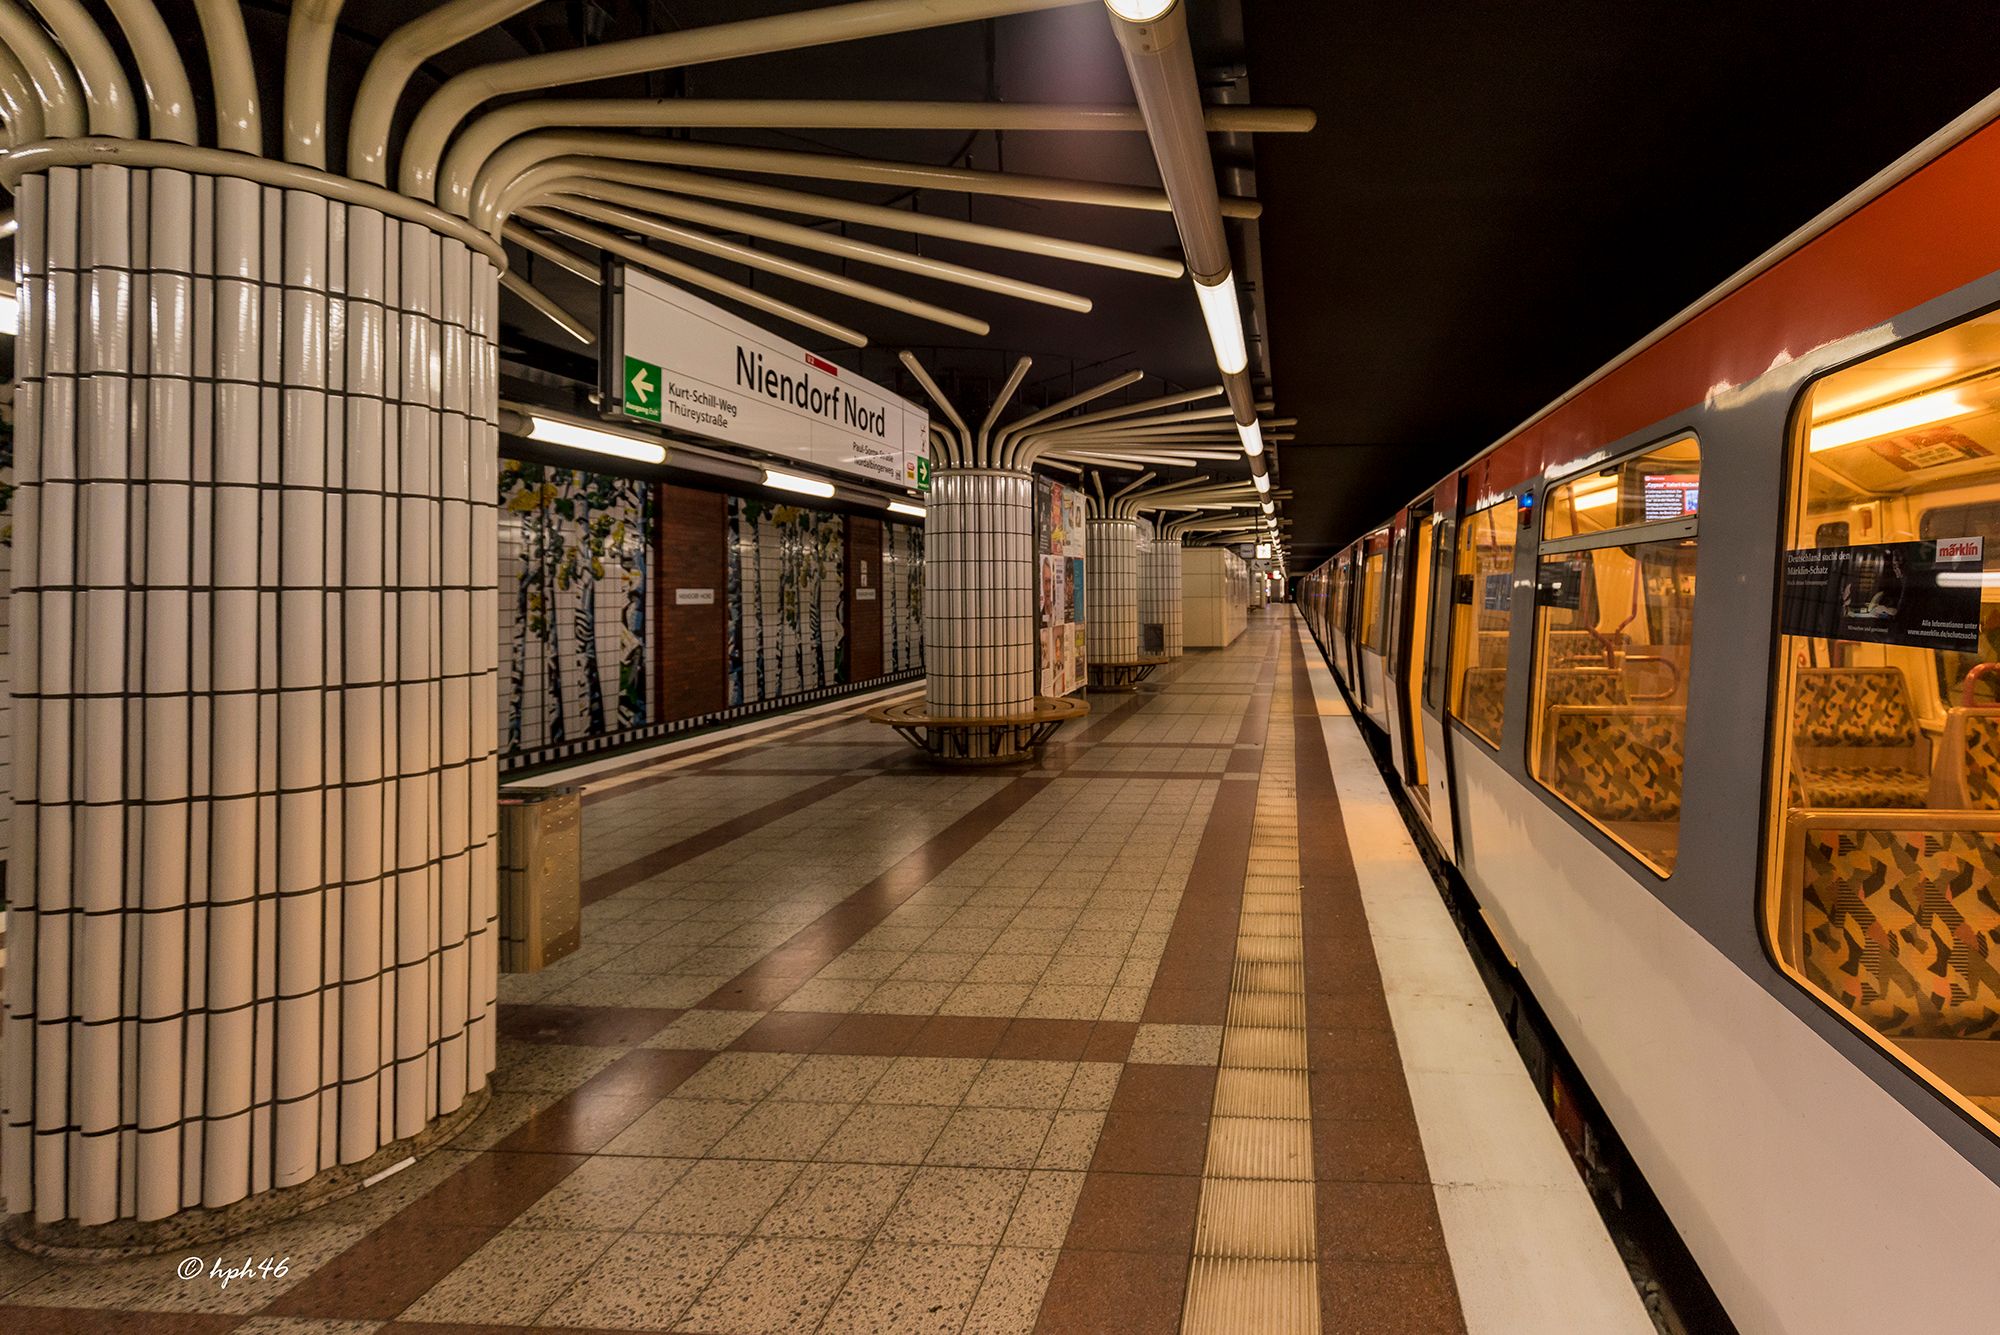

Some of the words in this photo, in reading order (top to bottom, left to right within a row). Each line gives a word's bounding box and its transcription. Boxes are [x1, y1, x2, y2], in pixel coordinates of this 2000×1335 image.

[668, 382, 737, 417] Kurt-Schill-Weg
[737, 345, 839, 420] Niendorf
[844, 392, 885, 437] Nord
[668, 400, 728, 428] Thüreystraße
[1939, 543, 1978, 556] märklin
[1932, 620, 1964, 629] Informationen
